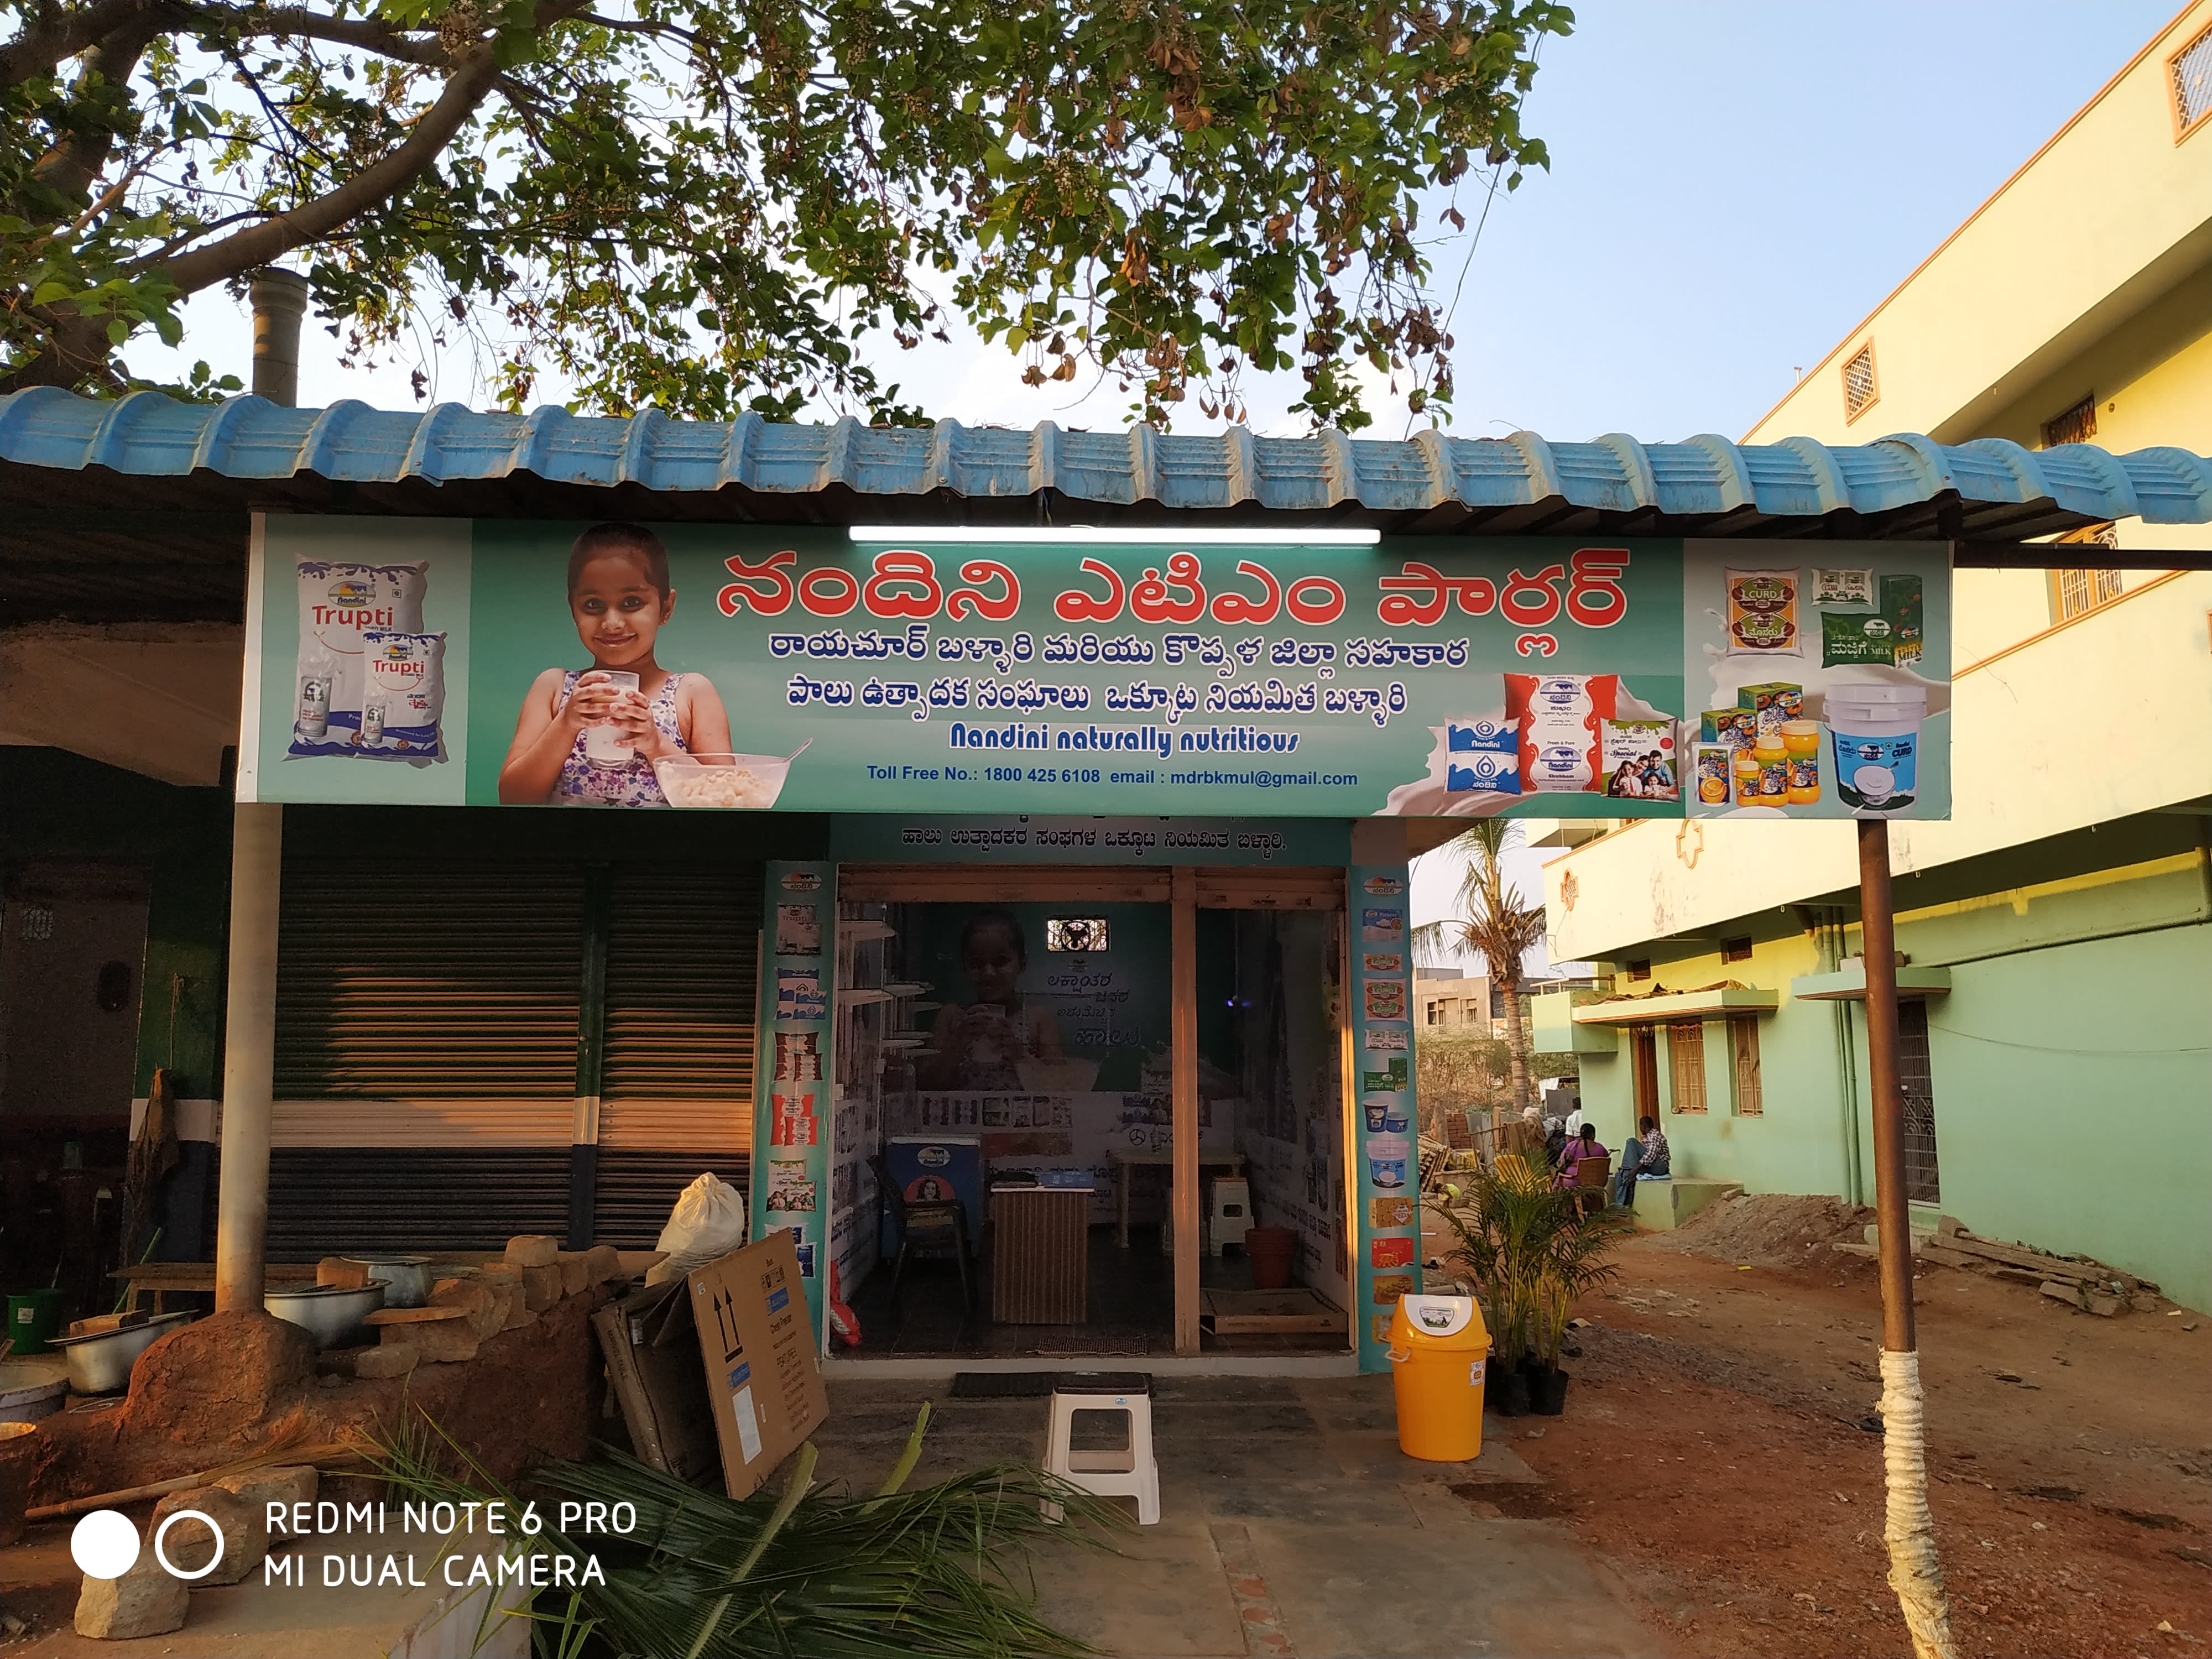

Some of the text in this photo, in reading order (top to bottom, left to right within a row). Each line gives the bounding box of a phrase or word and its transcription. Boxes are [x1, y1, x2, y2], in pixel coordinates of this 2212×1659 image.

[717, 548, 1630, 658] నందిని ఎటిఎం పార్లర్
[312, 605, 393, 630] Trupti
[1749, 628, 1778, 636] ಮೊಸರು
[769, 622, 1470, 680] రాయచూర్ బళ్ళారి మరియు కొప్పళ జిల్లా సహకార
[1831, 640, 1867, 659] ಮಜ್ಜಿಗೆ
[1898, 650, 1922, 662] MILK
[373, 660, 424, 676] Trupti
[786, 672, 1408, 728] పాలు ఉత్పాదక సంఘాలు ఒక్కూట నియమిత బళ్ళారి
[950, 721, 1300, 760] Nandini naturally nutritious
[1610, 749, 1637, 758] Special
[1892, 747, 1912, 757] CURD
[867, 765, 896, 780] Toll
[902, 766, 939, 780] Free
[945, 766, 978, 781] No.:
[984, 768, 1022, 782] 1800
[1027, 768, 1057, 782] 425
[1062, 769, 1100, 783] 6108
[1110, 769, 1155, 784] email
[1171, 770, 1358, 788] mdrbkmul@gmail.com
[902, 828, 942, 845] ಹಾಲು
[951, 827, 1027, 853] ಉತ್ಪಾದಕರ
[1035, 827, 1097, 849] ಸಂಘಗಳ
[1105, 829, 1156, 857] ಒಕ್ಕೂಟ
[1164, 830, 1230, 849] ನಿಯಮಿತ
[1047, 973, 1113, 993] ಲಕ್ಷಾಂತರ
